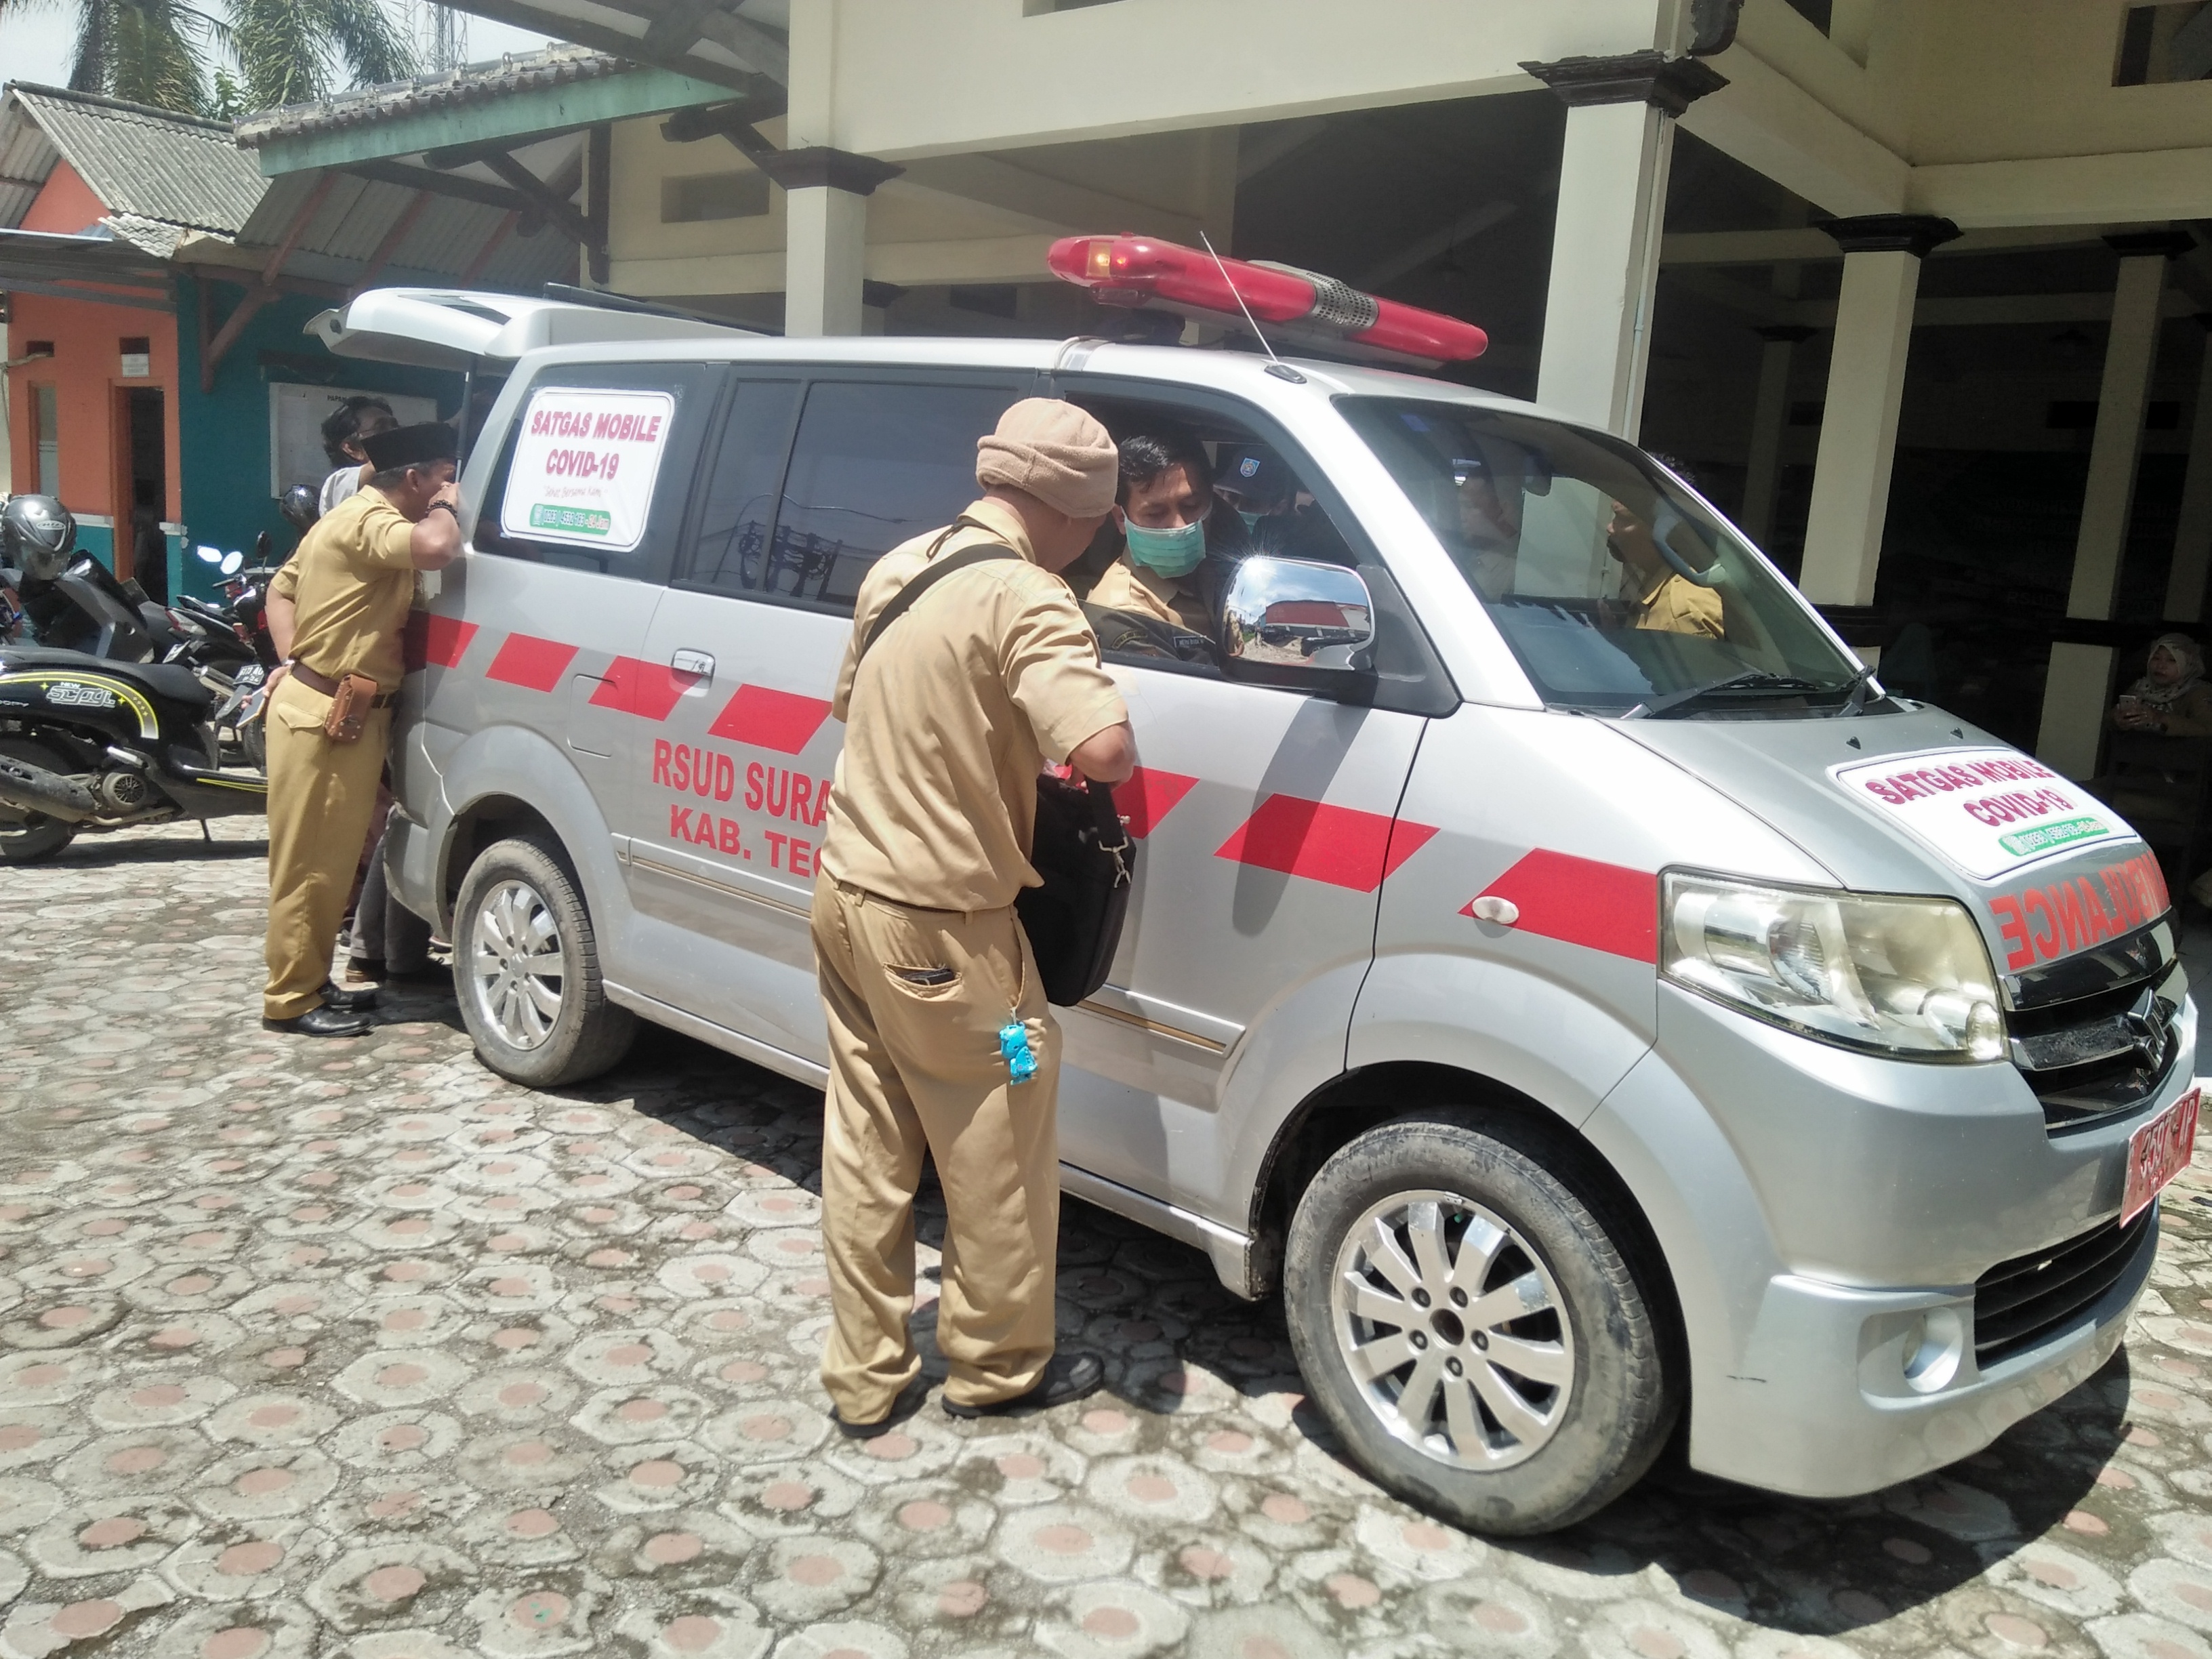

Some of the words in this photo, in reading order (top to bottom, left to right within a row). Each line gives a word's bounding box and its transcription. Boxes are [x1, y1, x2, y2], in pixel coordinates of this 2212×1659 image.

[531, 410, 593, 438] SATGAS
[593, 413, 662, 442] MOBILE
[546, 449, 619, 480] COVID-19
[652, 738, 735, 802] RSUD
[1865, 765, 1984, 805] SATGAS
[1966, 760, 2057, 783] MOBILE
[1963, 788, 2074, 827] COVID-19
[670, 804, 752, 861] KAB.
